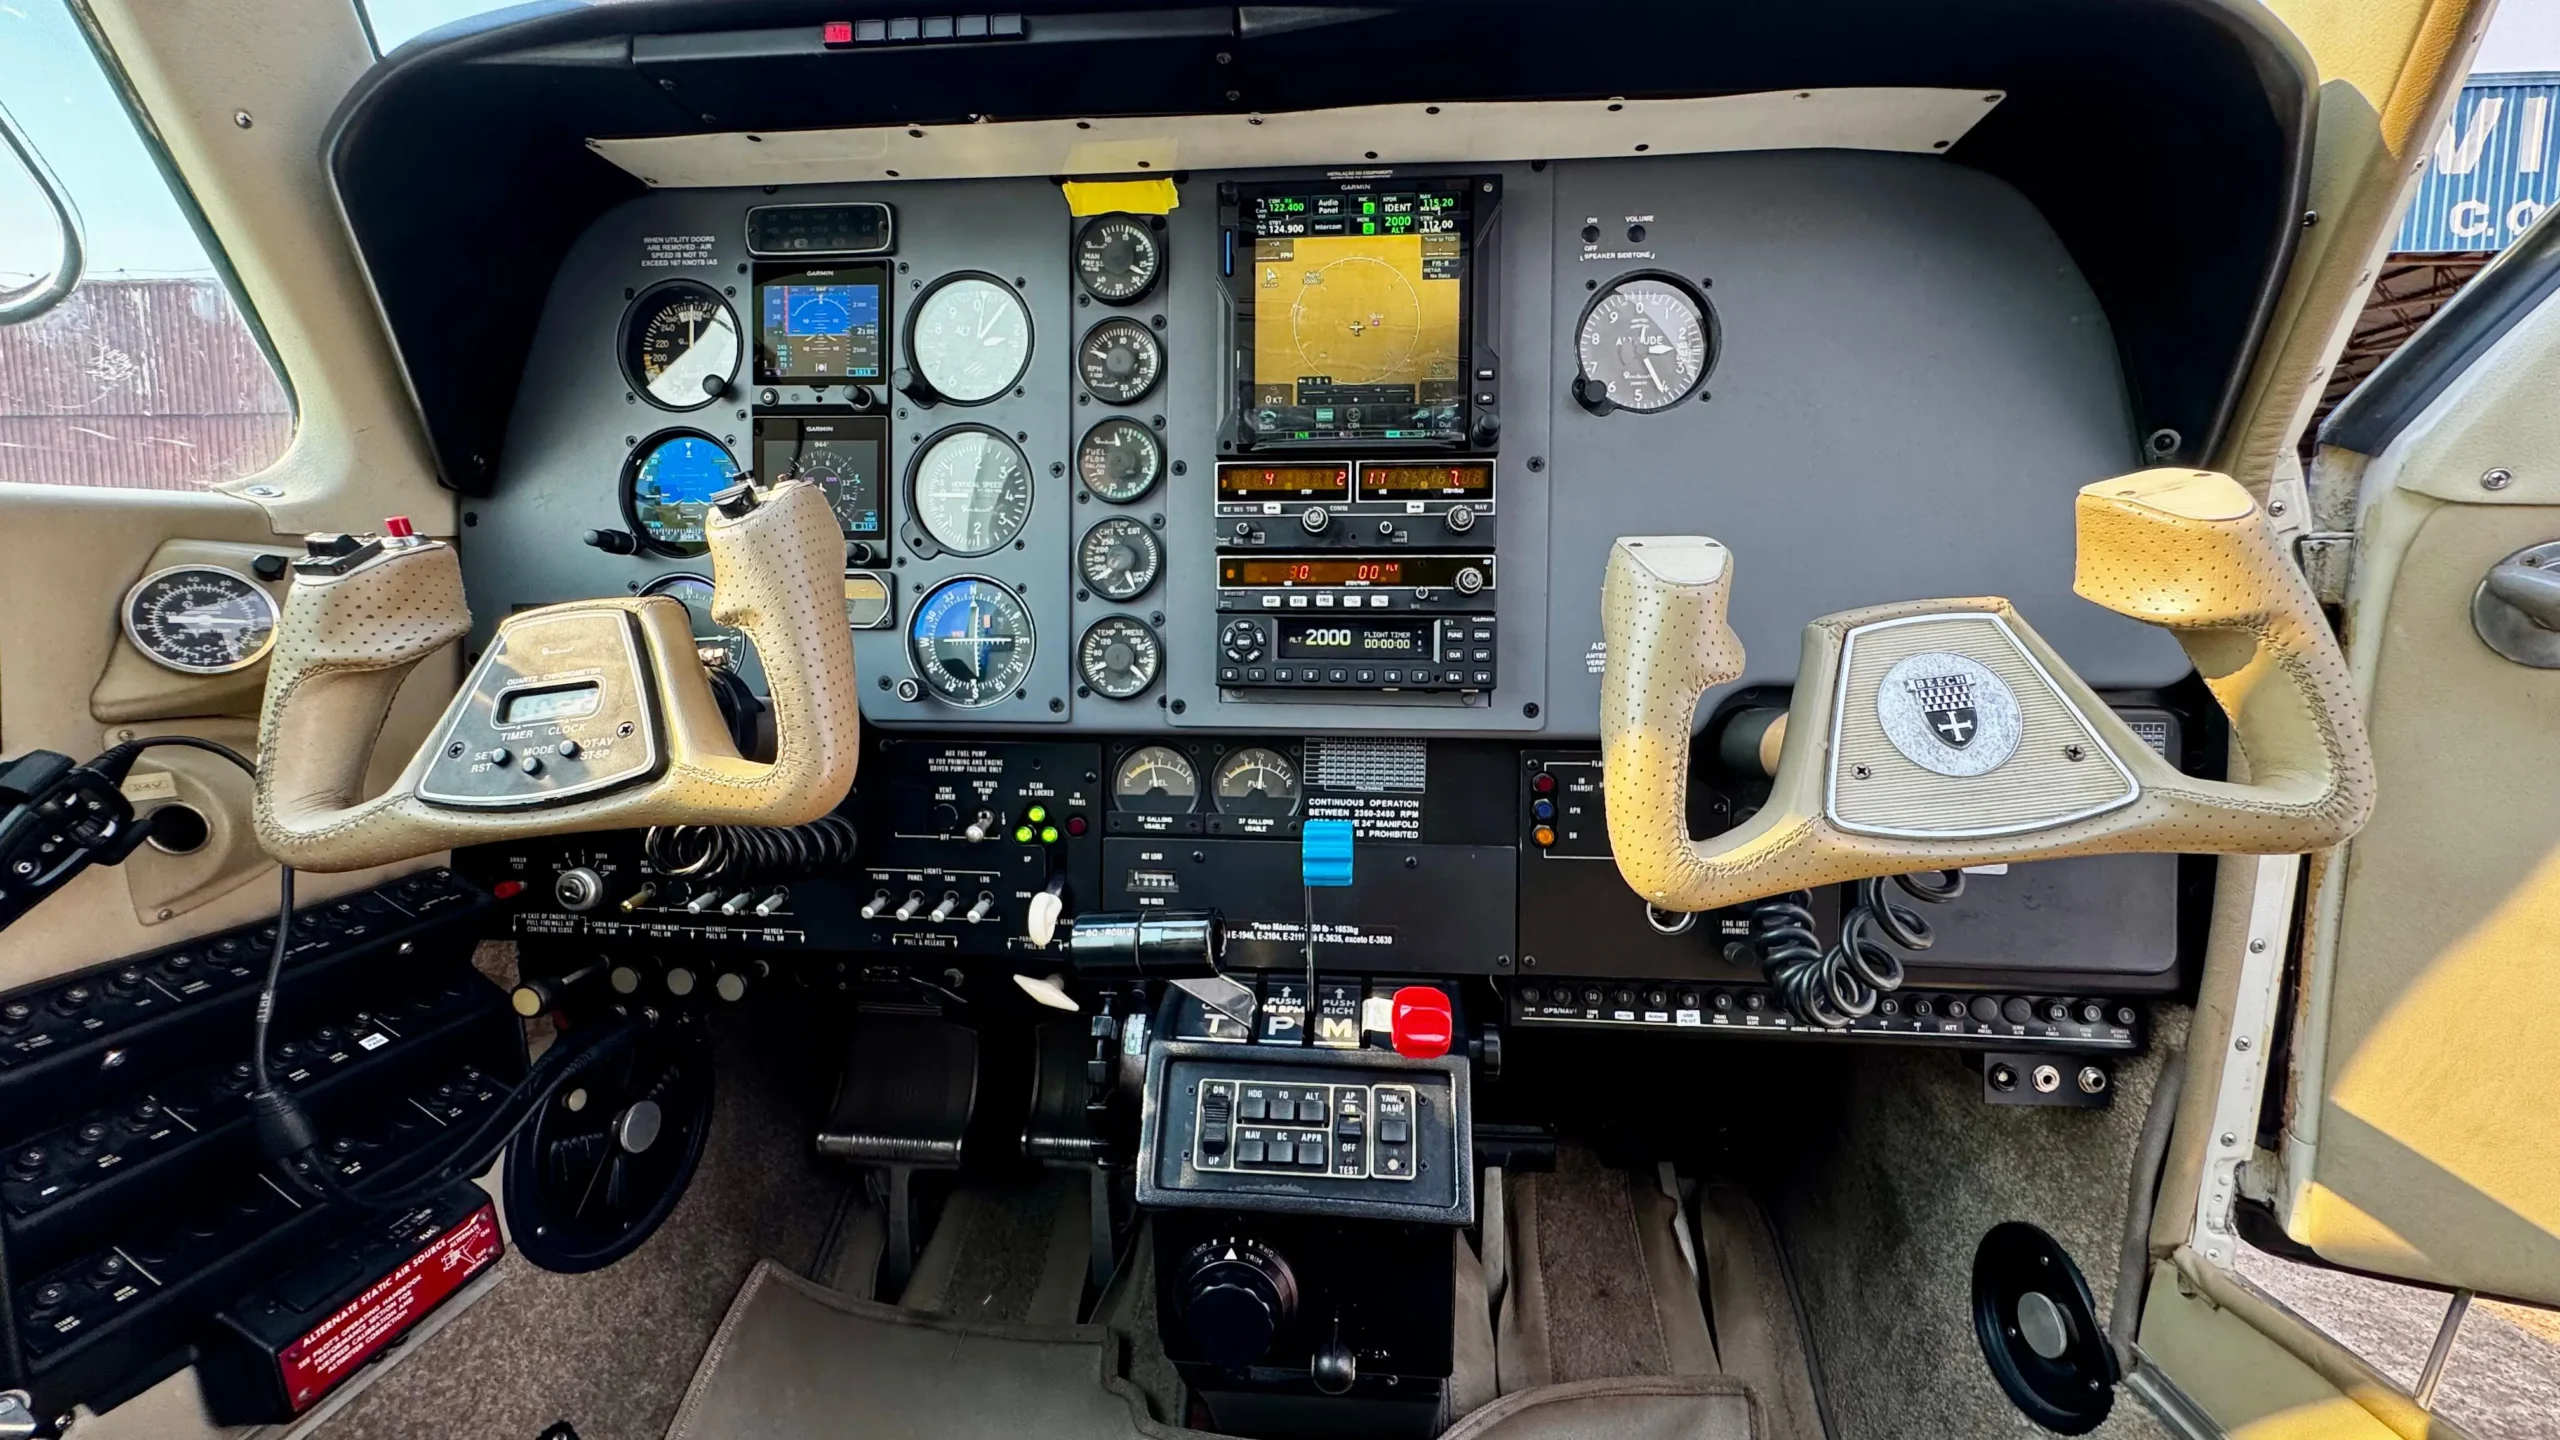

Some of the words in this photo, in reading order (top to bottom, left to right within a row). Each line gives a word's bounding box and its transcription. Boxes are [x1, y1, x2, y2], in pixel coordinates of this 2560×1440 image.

[1270, 203, 1304, 212] 122.400
[1384, 203, 1412, 212] IDENT
[1423, 198, 1453, 208] 115.20
[1385, 216, 1411, 226] 2000
[1423, 220, 1453, 229] 112.00
[1269, 225, 1304, 233] 124.900
[1636, 302, 1644, 314] 0
[1610, 312, 1618, 323] 9
[1592, 333, 1600, 344] 8
[1679, 328, 1686, 340] 2
[1608, 381, 1616, 393] 6
[1635, 389, 1643, 401] 5
[975, 457, 982, 469] 2
[999, 466, 1008, 478] 3
[1005, 490, 1014, 501] 4
[998, 513, 1006, 525] 3
[974, 522, 981, 534] 2
[970, 585, 976, 594] N
[1306, 629, 1351, 645] 2000
[1365, 639, 1410, 648] 00:00:00
[507, 676, 538, 686] QUARTZ
[543, 668, 601, 680] CHRONOMETER
[1916, 675, 1965, 689] BEECH
[501, 730, 534, 741] TIMER
[548, 724, 586, 736] CLOCK
[583, 737, 614, 748] DT-AV
[474, 751, 493, 760] SET
[523, 745, 555, 756] MODE
[580, 749, 610, 760] ST-SP
[471, 763, 492, 773] RST
[1369, 830, 1418, 838] PROHIBITED
[1204, 1014, 1229, 1034] T
[1268, 1016, 1295, 1035] P
[1323, 1018, 1352, 1038] M
[1248, 1090, 1262, 1098] HDG
[1344, 1104, 1356, 1112] ON
[1381, 1104, 1404, 1112] DAMP
[1245, 1131, 1261, 1139] NAV
[1277, 1132, 1287, 1140] BC
[1301, 1133, 1322, 1142] APPR
[1342, 1143, 1356, 1152] OFF
[1339, 1166, 1358, 1174] TEST
[450, 1224, 480, 1248] ALTERNATE
[480, 1227, 490, 1237] ON
[463, 1256, 488, 1277] NORMAL
[303, 1302, 359, 1348] ALTERNATE
[361, 1278, 393, 1305] STATIC
[395, 1265, 411, 1280] AIR
[412, 1238, 446, 1267] SOURCE
[341, 1305, 380, 1337] OPERATING
[382, 1274, 422, 1306] HANDBOOK
[366, 1308, 408, 1344] CORRECTION
[314, 1324, 367, 1366] PERFORMANCE
[368, 1301, 397, 1325] SECTION
[317, 1344, 350, 1373] AIRSPEED
[352, 1309, 397, 1346] CALIBRATION
[399, 1296, 414, 1311] AND
